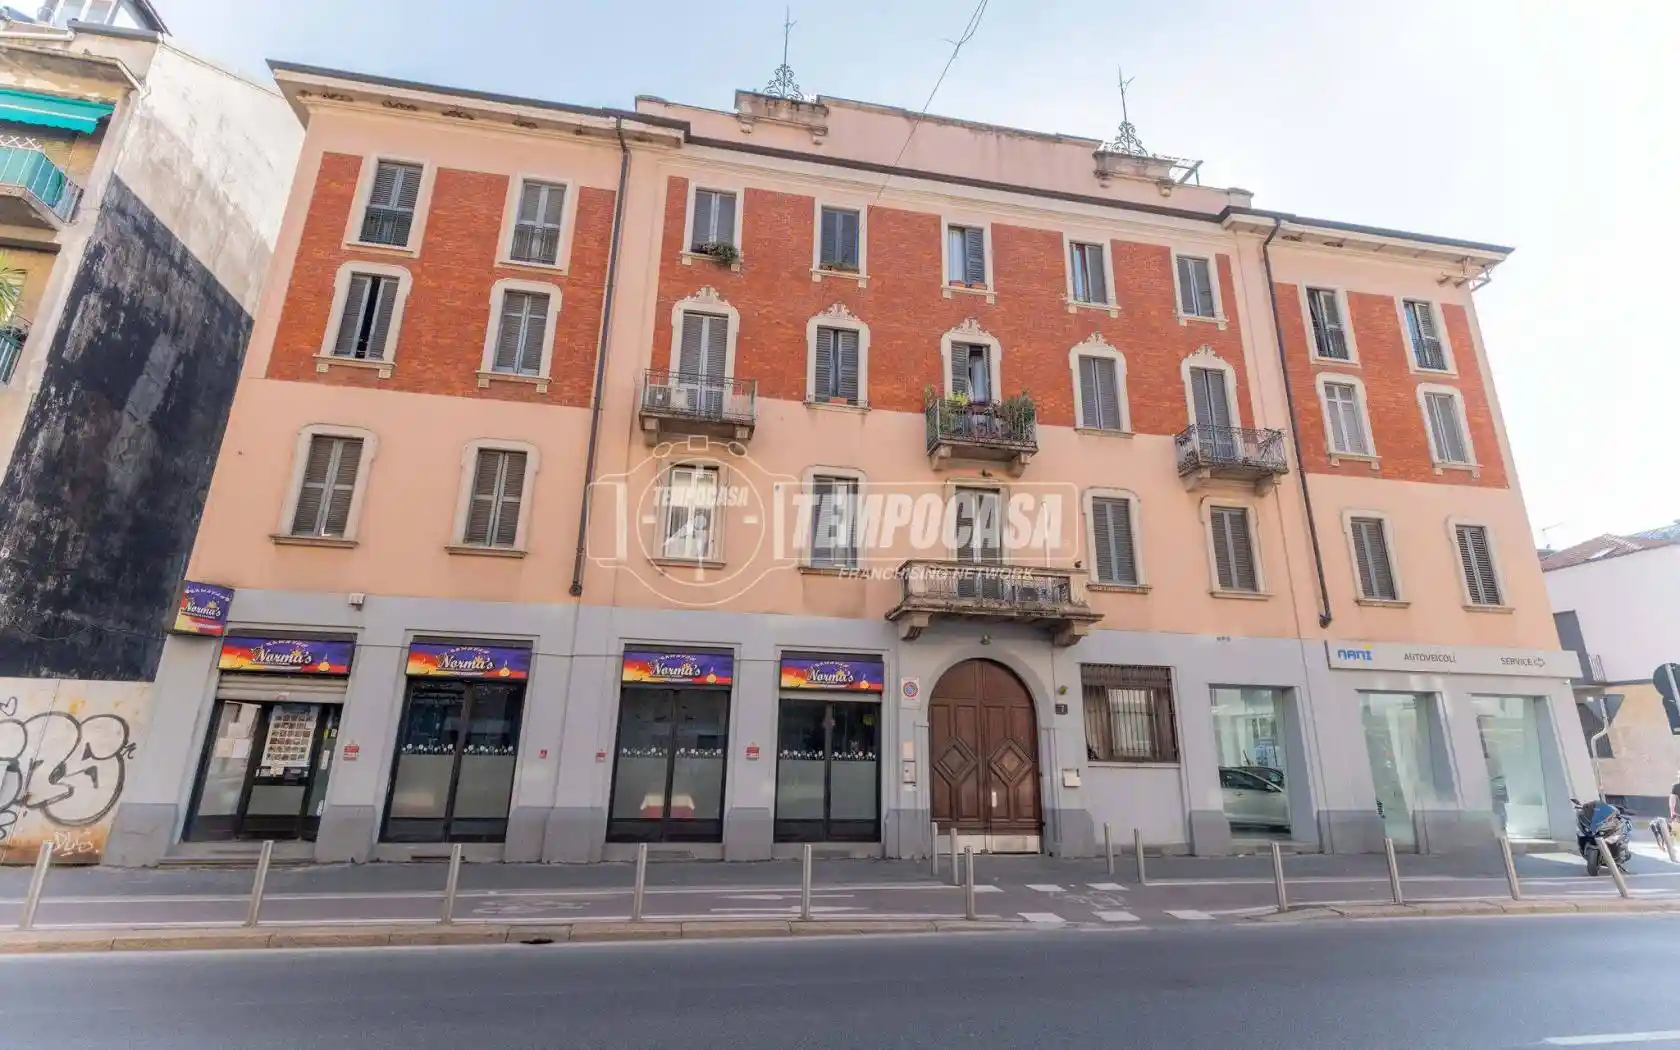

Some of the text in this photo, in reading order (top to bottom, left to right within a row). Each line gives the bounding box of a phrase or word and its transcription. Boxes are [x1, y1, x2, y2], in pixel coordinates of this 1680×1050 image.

[253, 644, 313, 664] Norma's
[438, 652, 494, 670] Norma's
[1500, 656, 1534, 666] SERVICE
[653, 660, 701, 677] Norma's
[808, 666, 854, 683] Norma's
